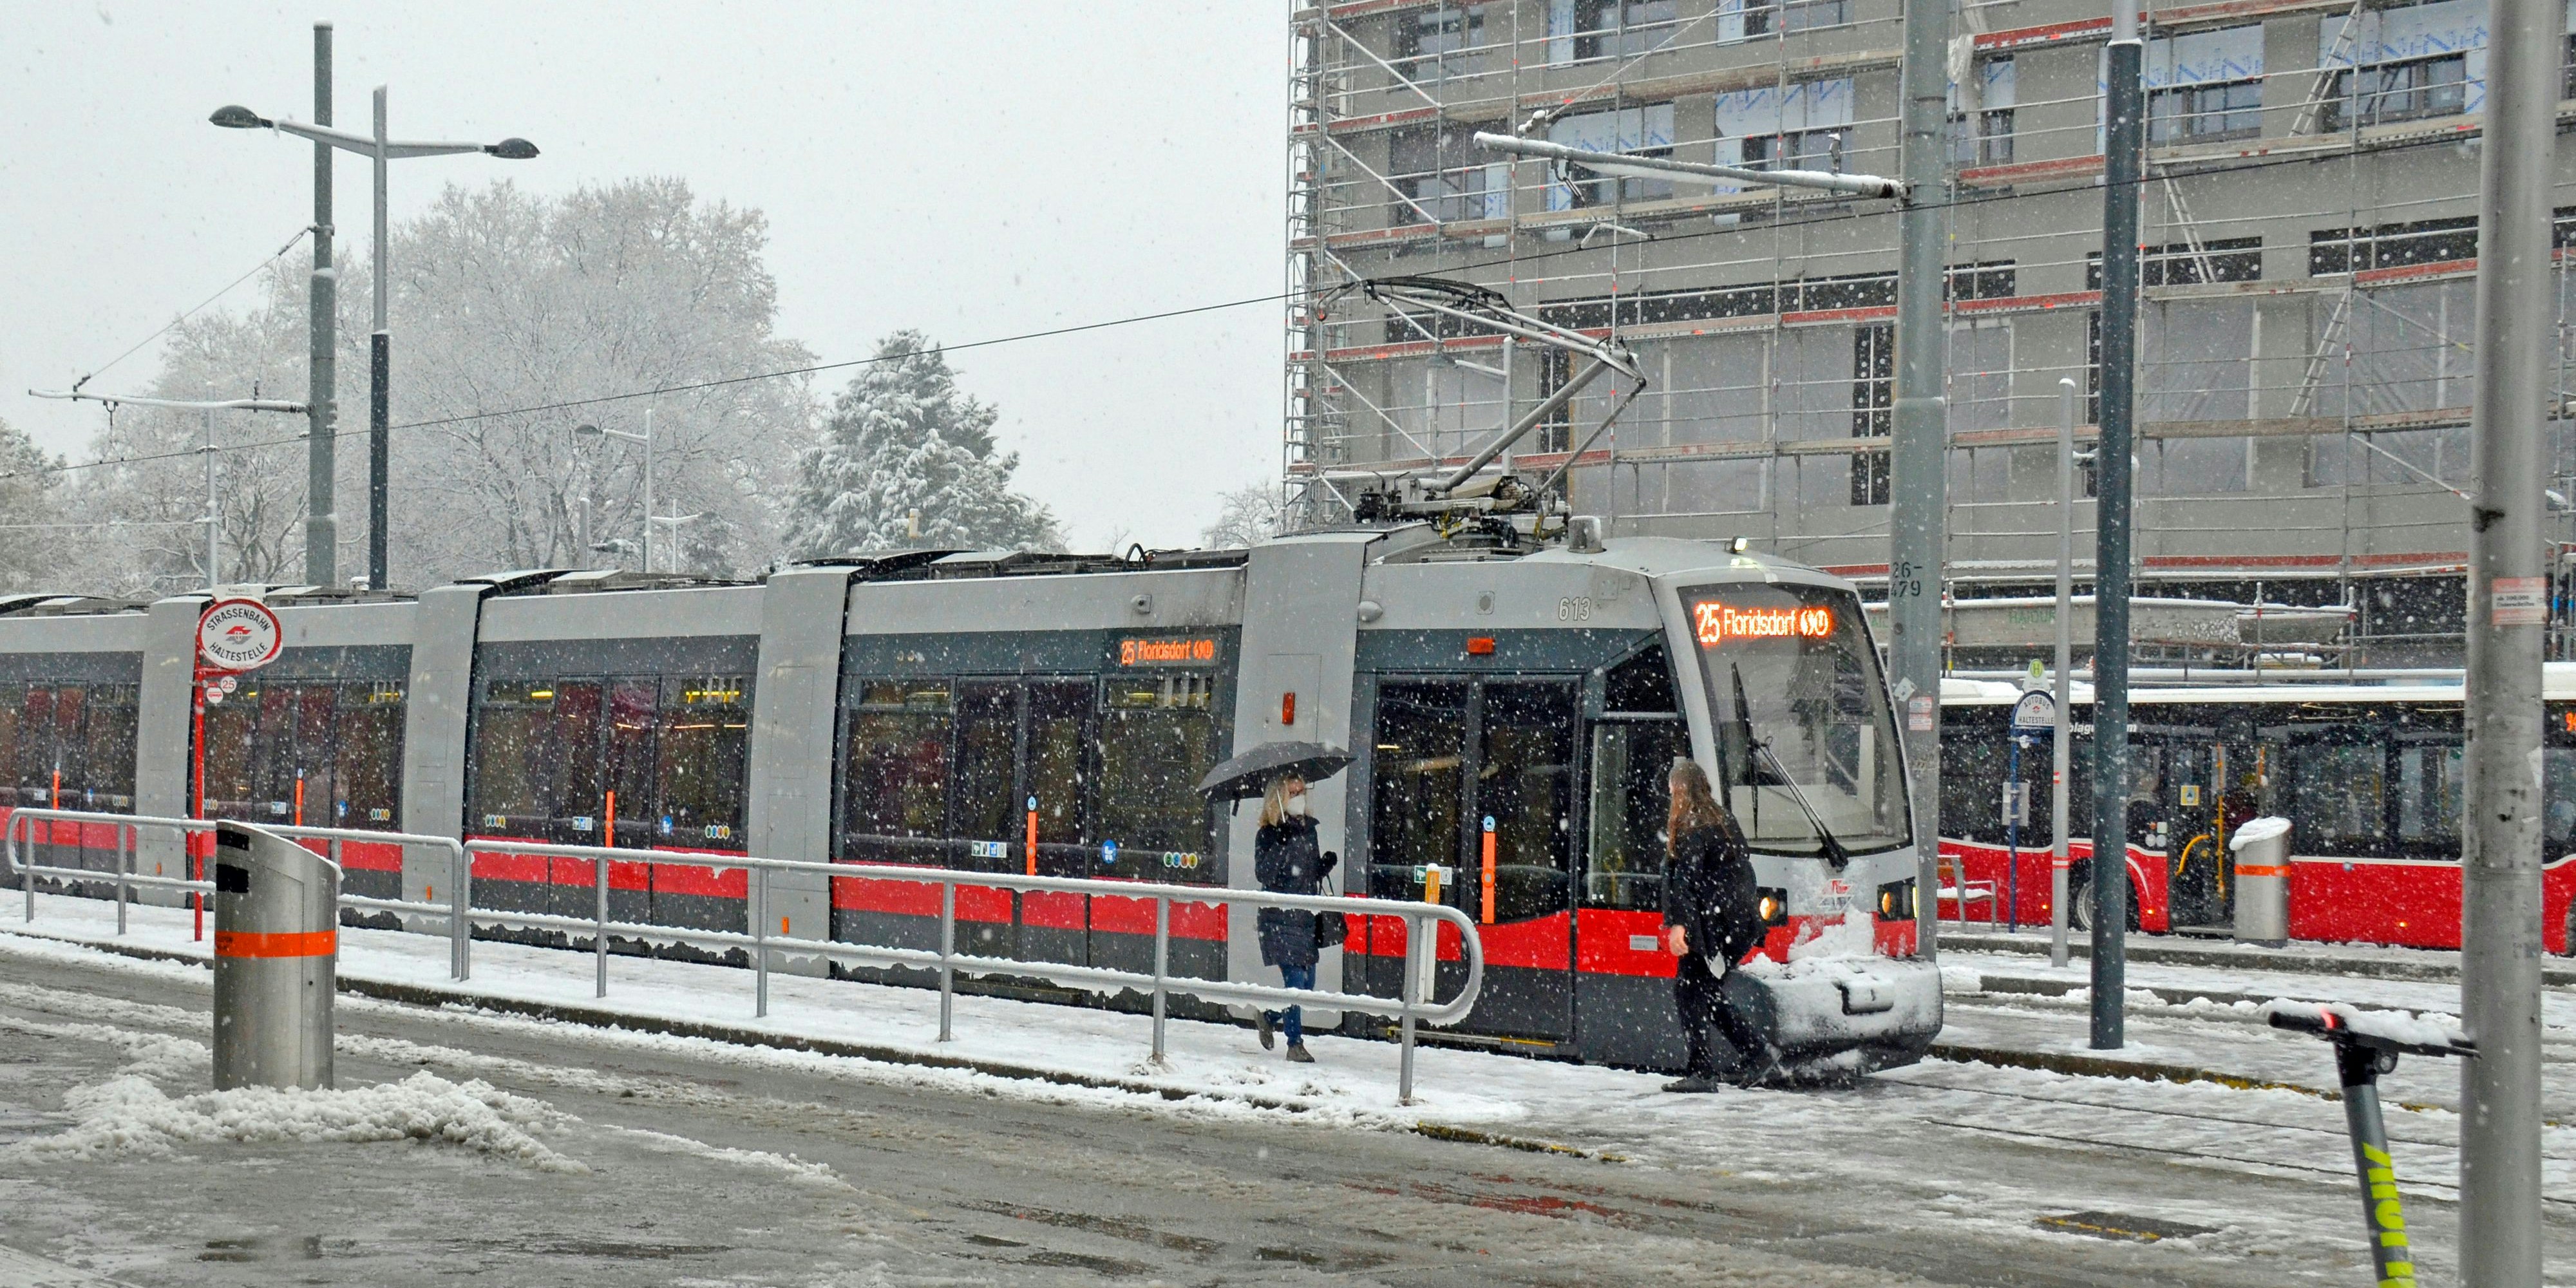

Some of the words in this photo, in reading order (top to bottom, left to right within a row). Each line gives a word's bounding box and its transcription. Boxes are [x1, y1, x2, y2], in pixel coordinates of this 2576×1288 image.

[1890, 580, 1921, 598] 479
[1558, 596, 1591, 621] 613
[207, 608, 271, 632] STRASSENBAHN
[1696, 603, 1720, 643] 25
[1723, 608, 1795, 636] Floridsdorf
[209, 641, 268, 662] HALTESTELLE
[1121, 640, 1135, 665] 25
[1138, 639, 1191, 660] Floridsdorf
[222, 680, 235, 689] 25
[2023, 696, 2050, 710] AUTOBUS
[2018, 715, 2054, 725] HALTESTELLE
